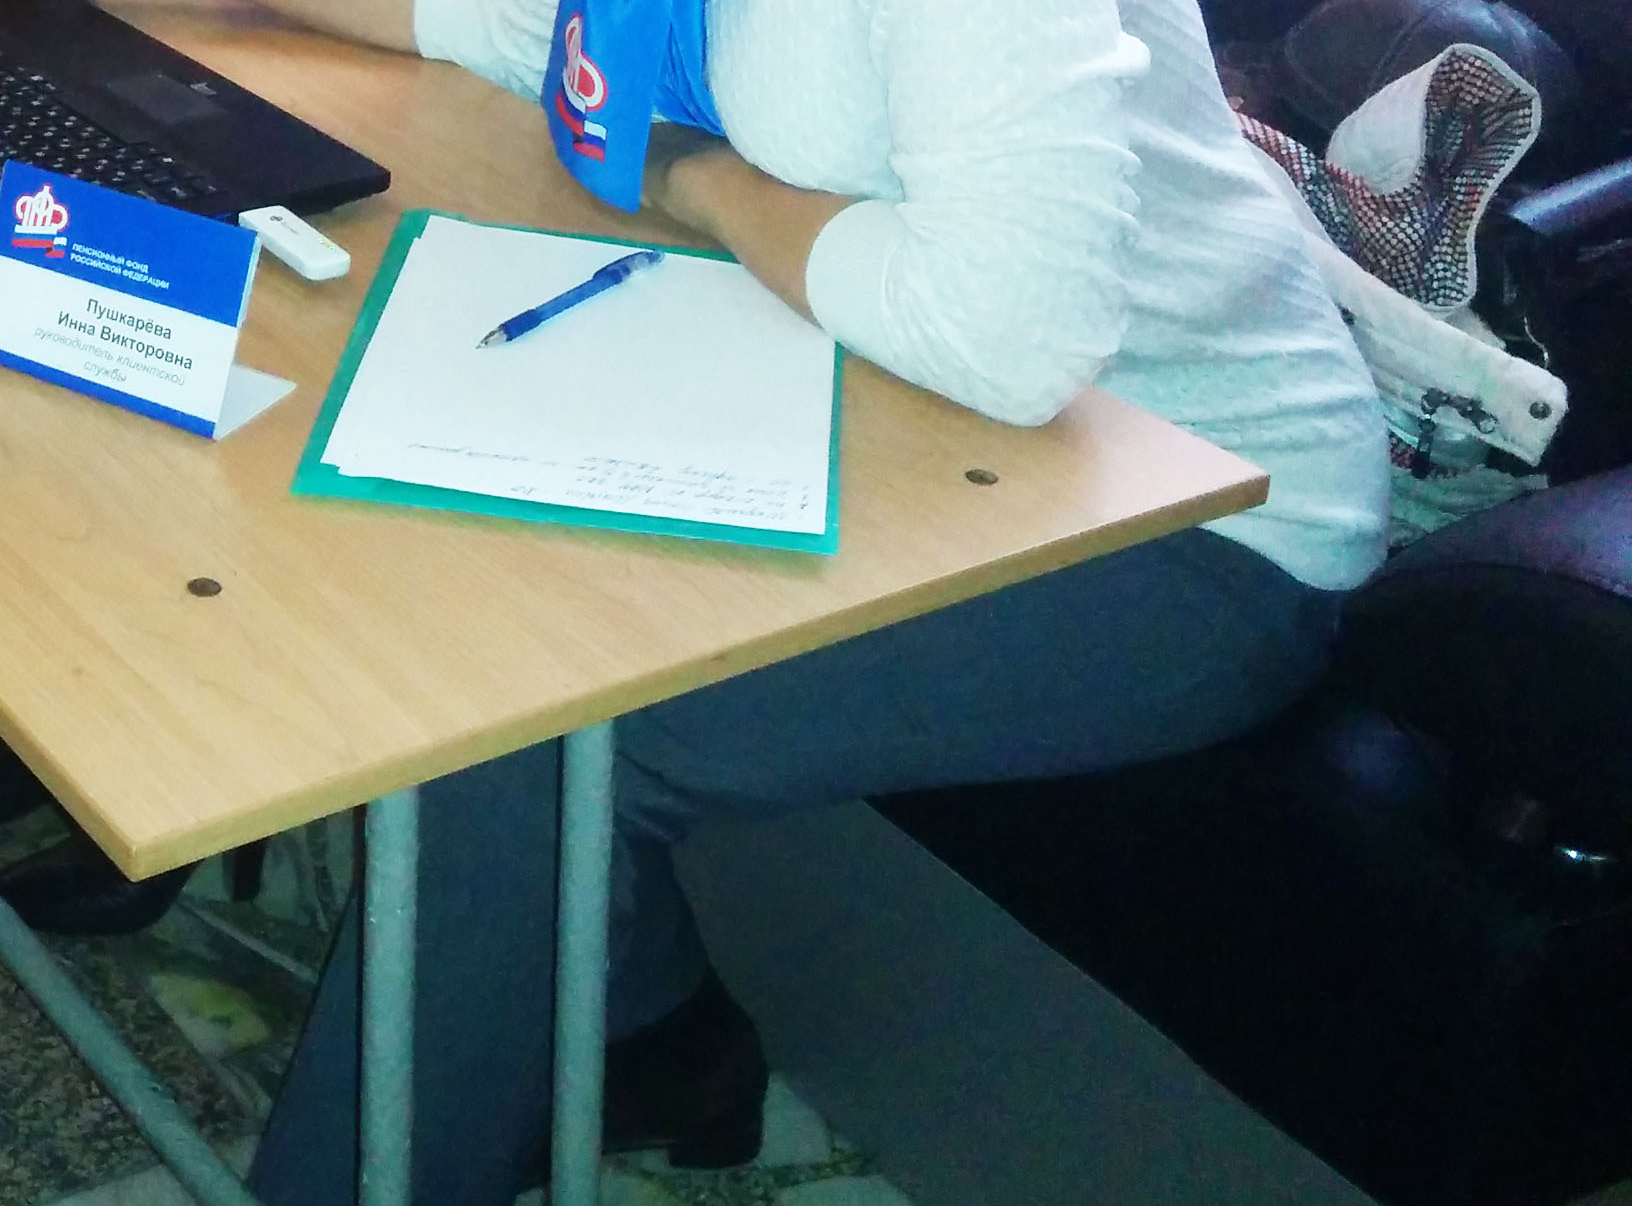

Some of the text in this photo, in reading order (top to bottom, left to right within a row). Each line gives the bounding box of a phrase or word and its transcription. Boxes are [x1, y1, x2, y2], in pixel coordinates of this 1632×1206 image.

[70, 253, 170, 290] РОССИЙСКОЙ ФЕДЕРАЦИИ
[71, 243, 149, 274] ПЕНСИОННЫЙ ФОНД
[86, 298, 172, 340] Пушкарёва
[33, 327, 186, 386] руководитель клиентской
[57, 310, 193, 370] Инна Викторовна
[83, 361, 127, 383] службы
